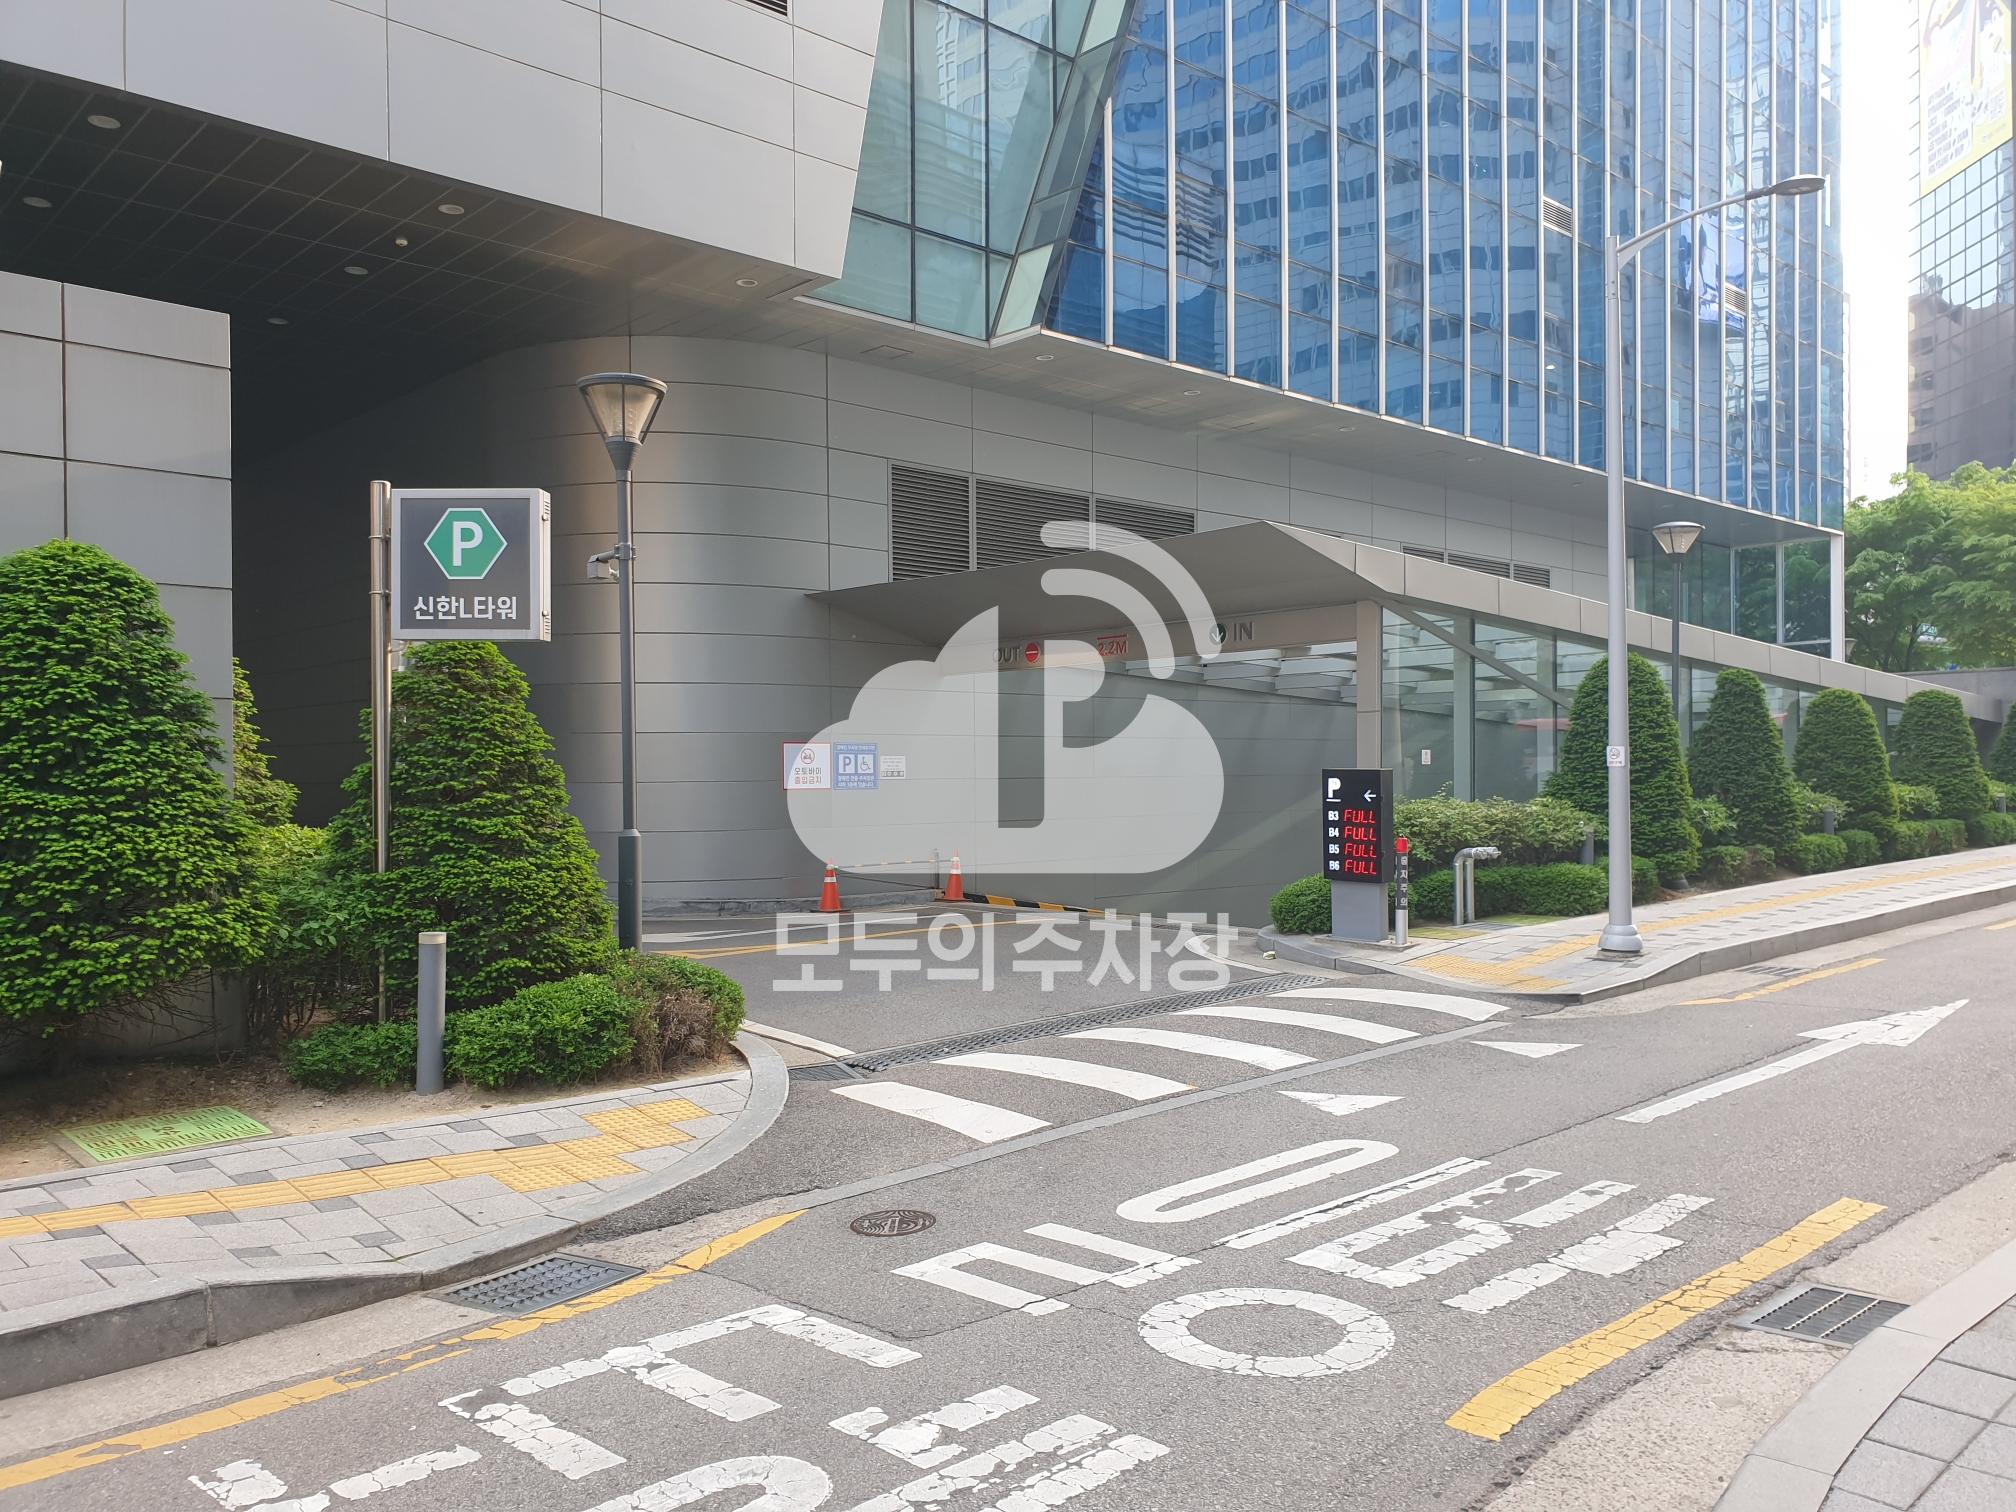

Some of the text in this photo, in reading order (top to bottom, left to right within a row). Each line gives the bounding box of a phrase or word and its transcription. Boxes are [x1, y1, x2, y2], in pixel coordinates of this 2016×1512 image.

[453, 521, 483, 567] P
[413, 596, 517, 620] 신한L타워
[1234, 621, 1254, 641] IN
[795, 767, 822, 776] 오토바이
[795, 776, 822, 784] 출입금지
[1328, 778, 1341, 798] P
[1328, 809, 1376, 824] B3 FULL
[1328, 826, 1376, 840] B4 FULL
[1329, 843, 1376, 857] B5 FULL
[1329, 859, 1376, 874] B6 FULL
